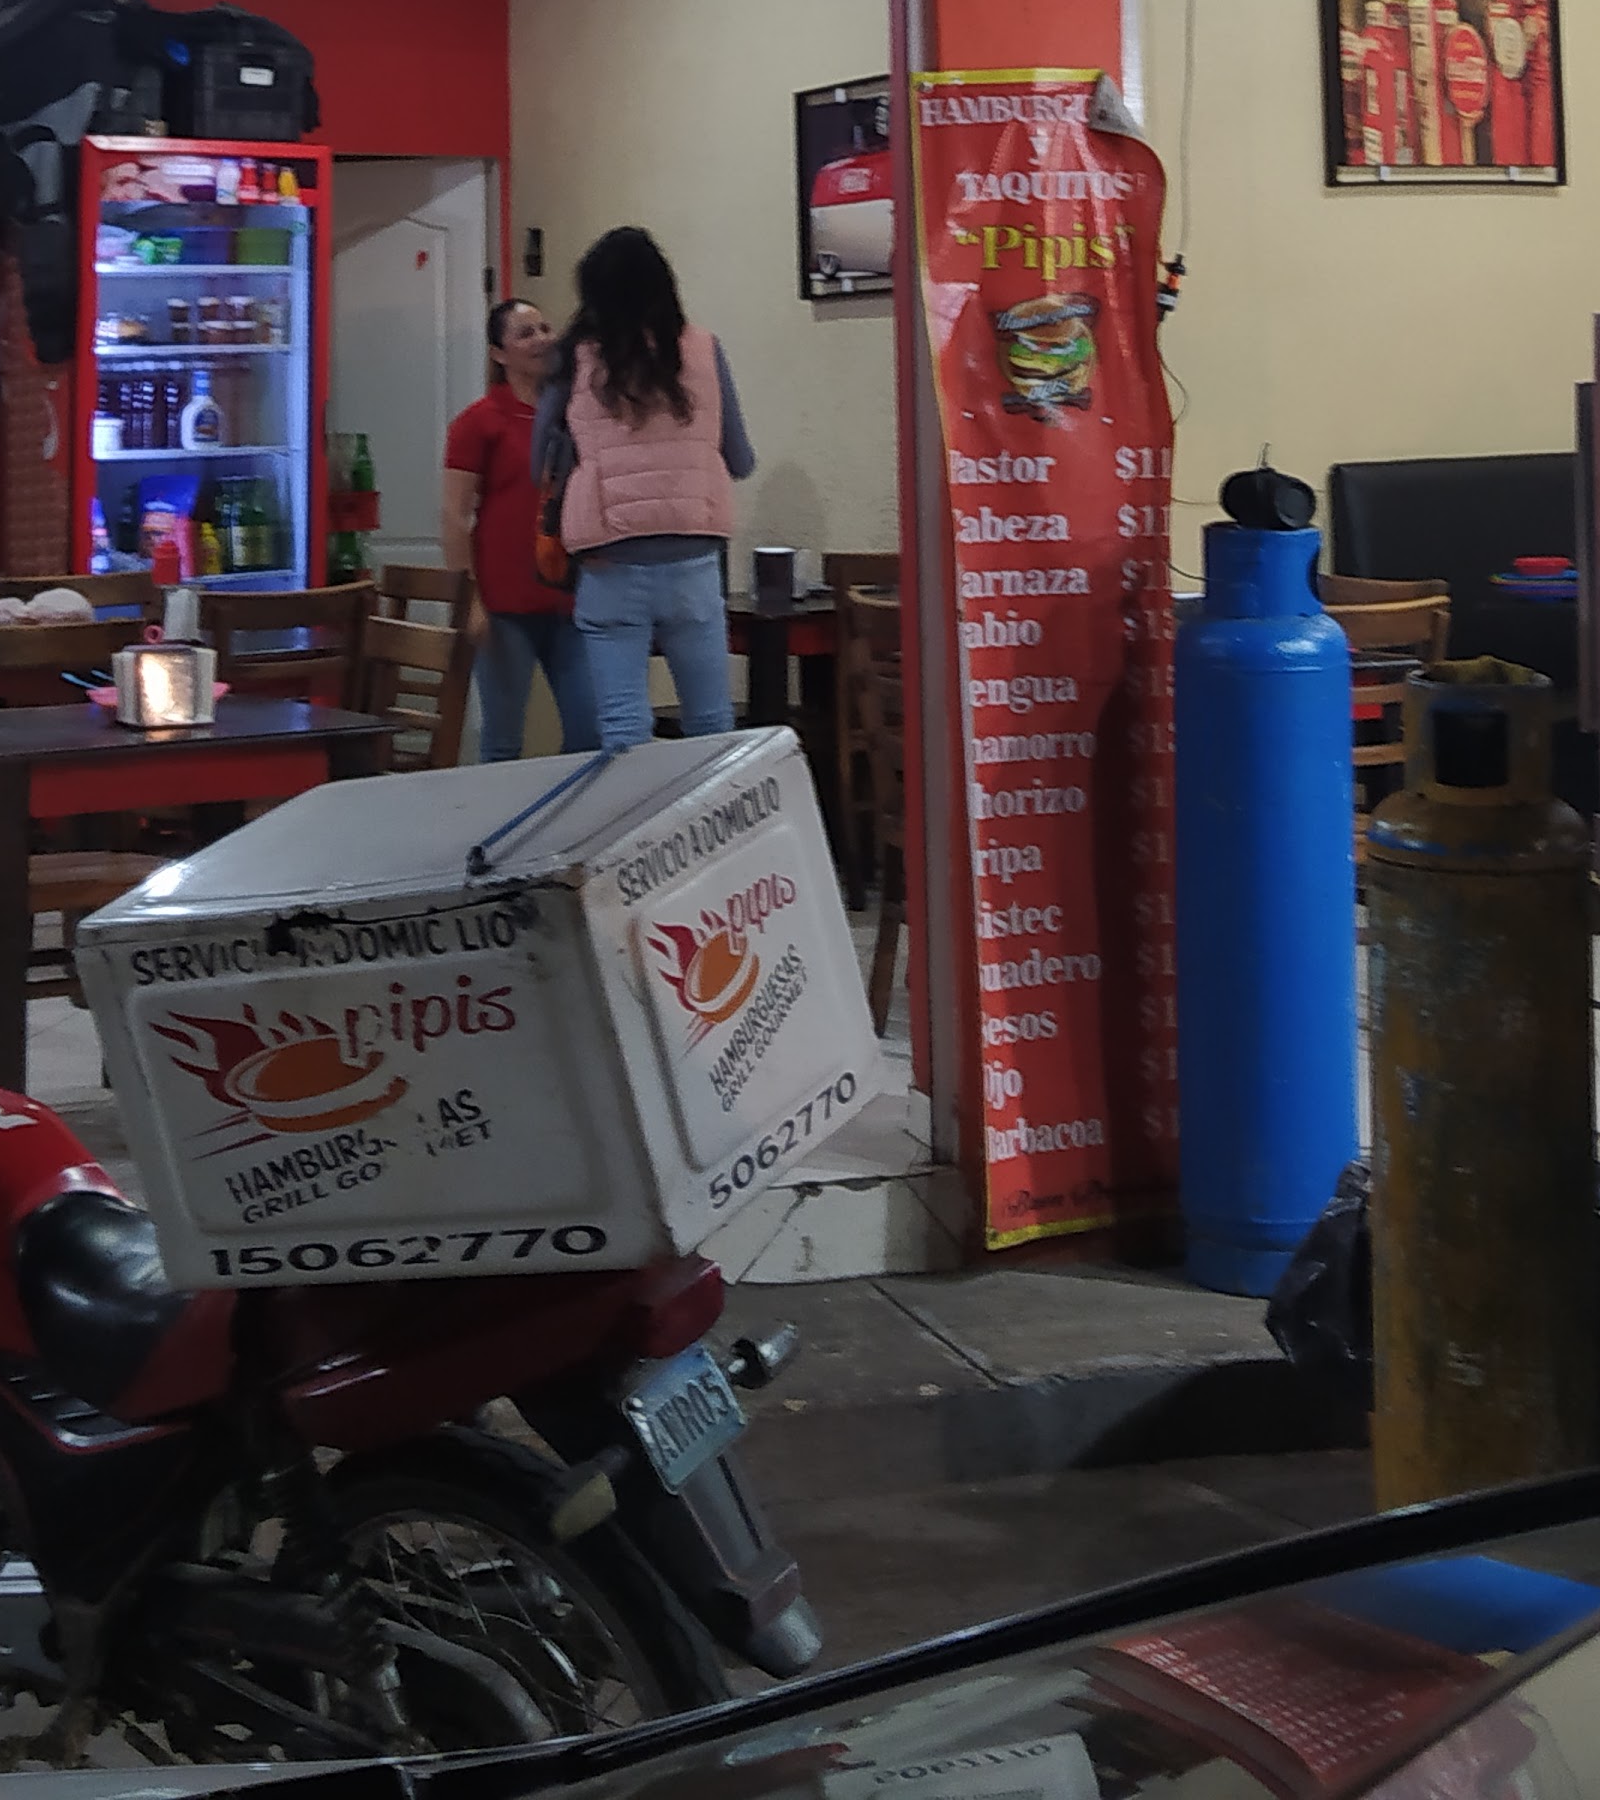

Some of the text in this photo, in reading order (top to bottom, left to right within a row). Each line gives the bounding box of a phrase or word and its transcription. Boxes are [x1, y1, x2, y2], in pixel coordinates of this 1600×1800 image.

[956, 170, 1133, 204] TAQUITOS
[956, 506, 1071, 543] abeza
[957, 566, 1090, 599] arnaza
[960, 611, 1042, 649] abio
[967, 675, 1079, 713] engua
[968, 778, 1086, 820] horizo
[617, 831, 688, 906] SERVICIO
[701, 776, 780, 852] DOMICILIO
[973, 840, 1042, 884] ripa
[727, 873, 797, 950] pipis
[131, 935, 290, 986] SERVIC
[980, 949, 1102, 993] uadero
[344, 974, 517, 1059] pipis
[709, 944, 803, 1095] HAMBURGUESAS
[981, 1011, 1059, 1047] esos
[242, 1183, 329, 1225] GRILL
[210, 1225, 607, 1276] 15062770
